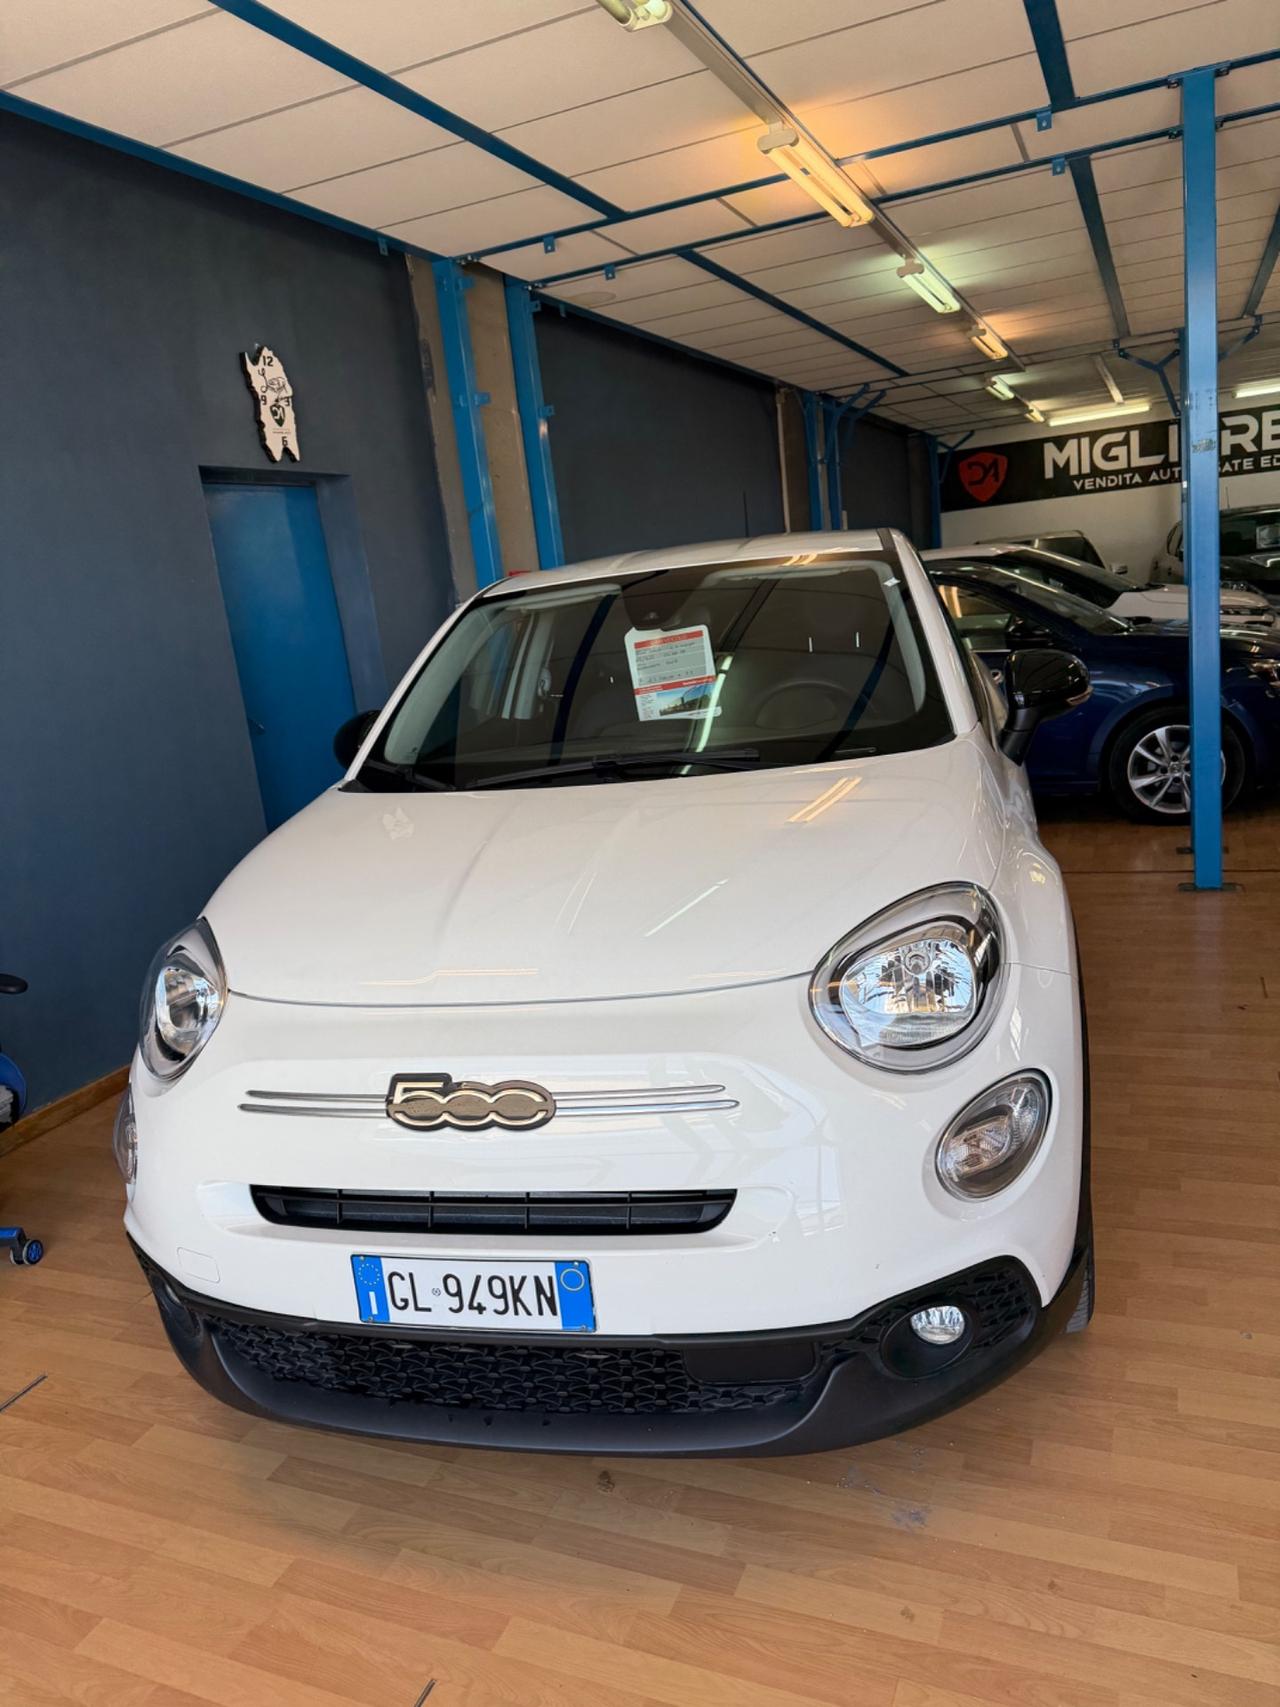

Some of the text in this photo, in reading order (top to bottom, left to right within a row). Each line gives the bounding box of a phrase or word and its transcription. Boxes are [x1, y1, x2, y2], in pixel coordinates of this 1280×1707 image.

[262, 355, 274, 367] 12
[260, 394, 267, 405] 9
[281, 436, 288, 447] 6
[1043, 410, 1280, 479] MIGLIRE
[1073, 473, 1142, 491] VENDITA
[1149, 467, 1182, 482] AUT
[392, 1081, 549, 1126] 500
[387, 1271, 558, 1317] GL 949KN
